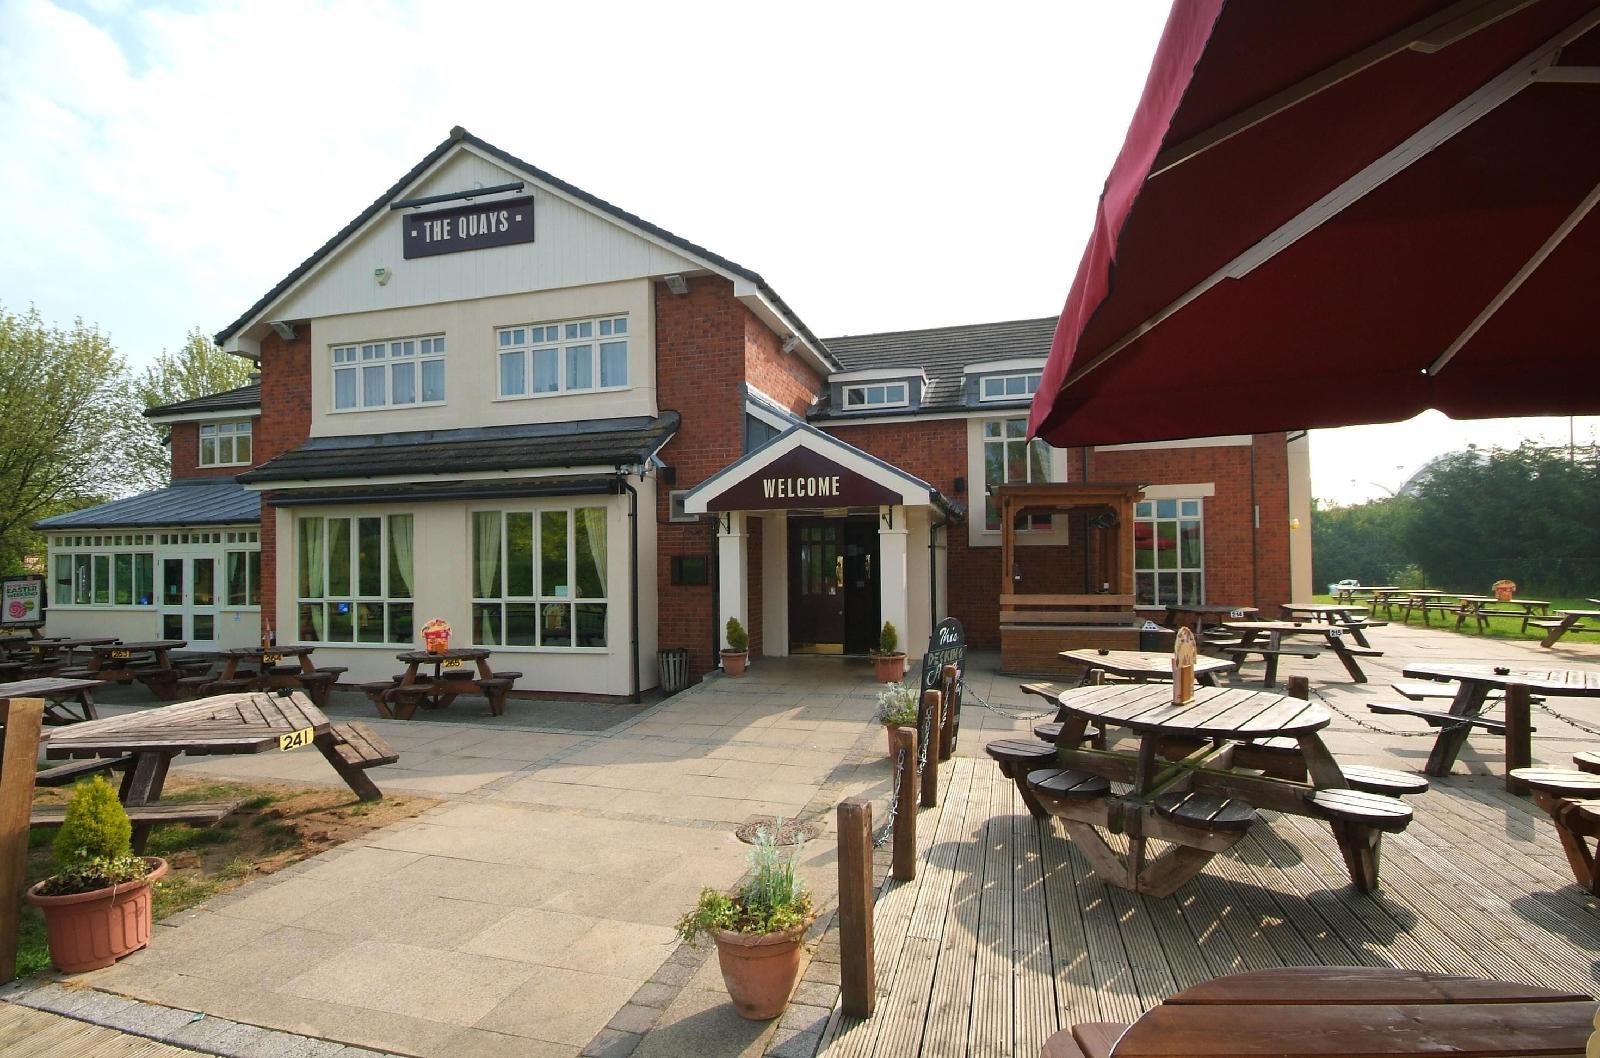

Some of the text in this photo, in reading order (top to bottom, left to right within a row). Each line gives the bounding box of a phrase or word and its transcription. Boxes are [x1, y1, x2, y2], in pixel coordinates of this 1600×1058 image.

[424, 210, 509, 243] THE QUAYS
[763, 476, 840, 498] WELCOME
[939, 626, 960, 645] This
[283, 730, 308, 751] 241
